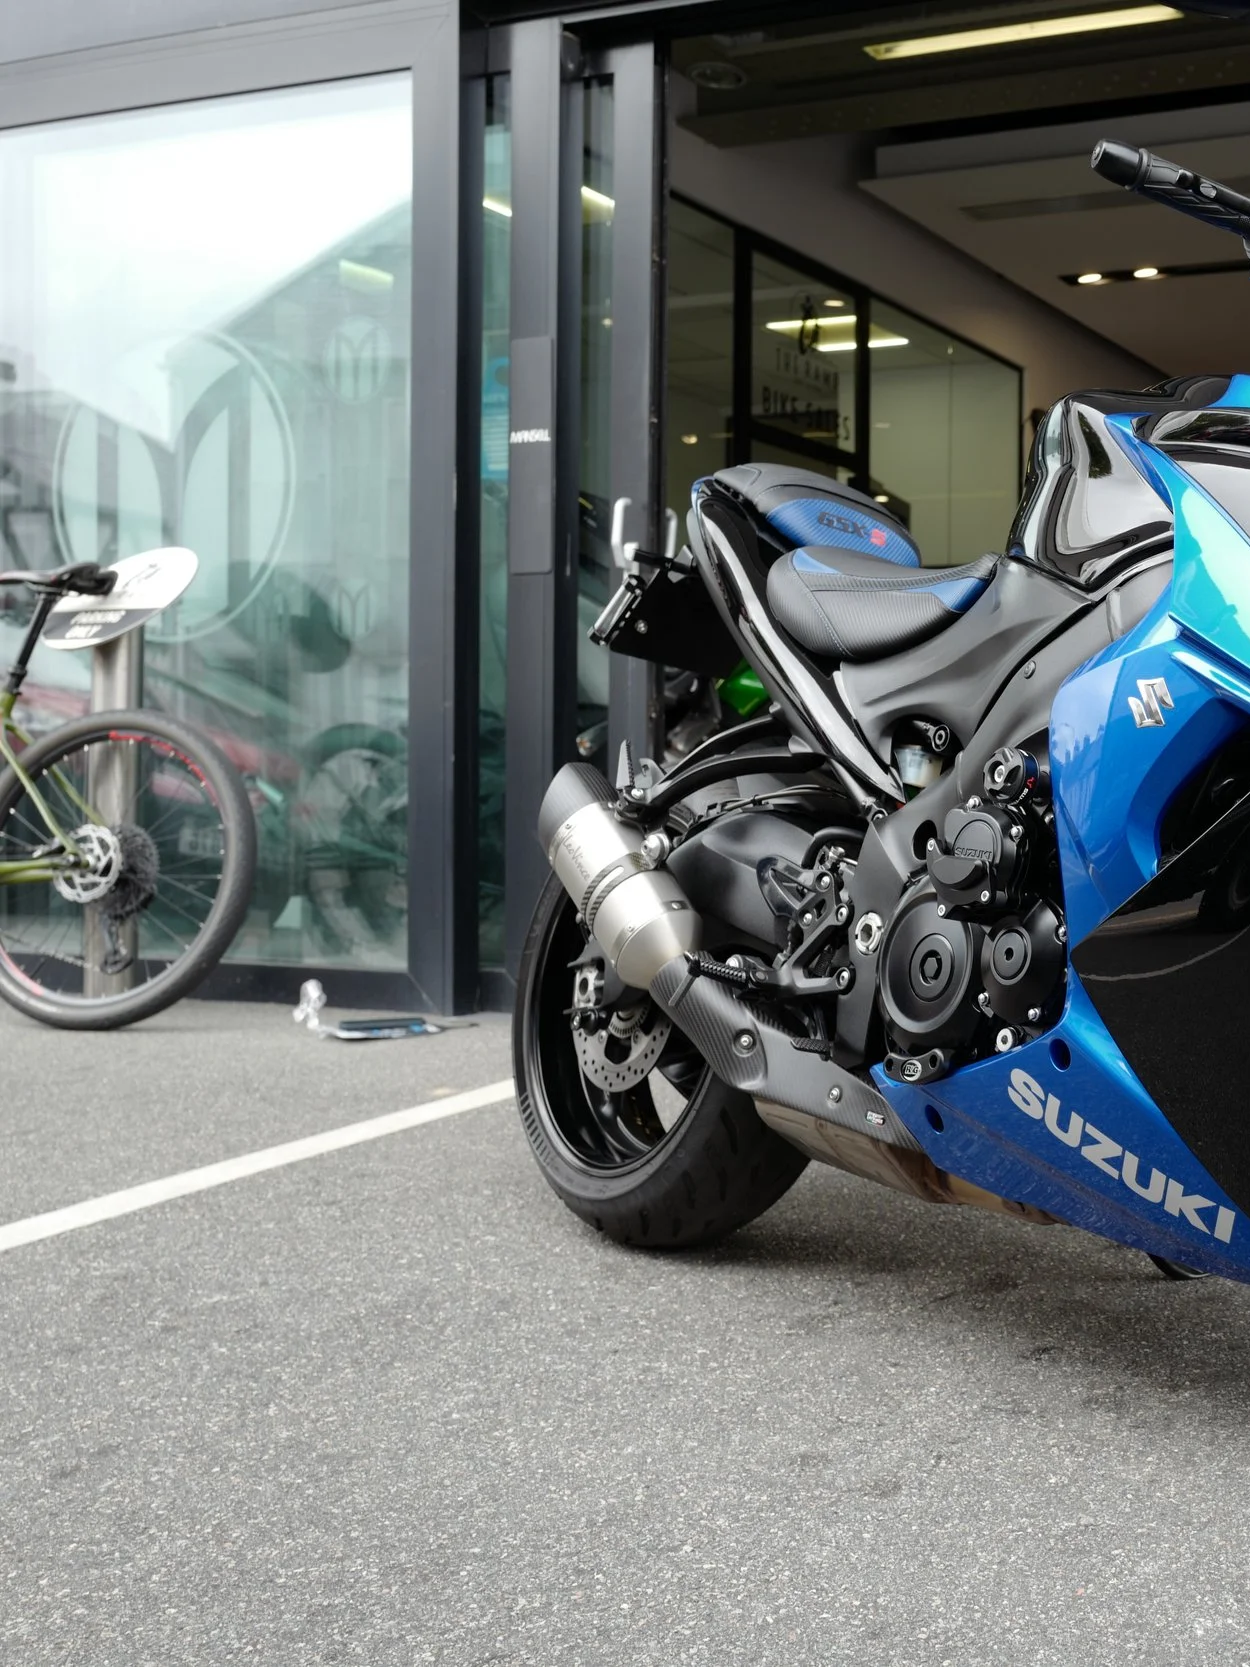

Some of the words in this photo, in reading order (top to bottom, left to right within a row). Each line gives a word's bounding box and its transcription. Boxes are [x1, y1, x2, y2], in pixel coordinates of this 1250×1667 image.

[817, 510, 888, 548] GSX-S
[954, 846, 993, 860] SUZUKI
[1007, 1067, 1237, 1245] SUZUKI
